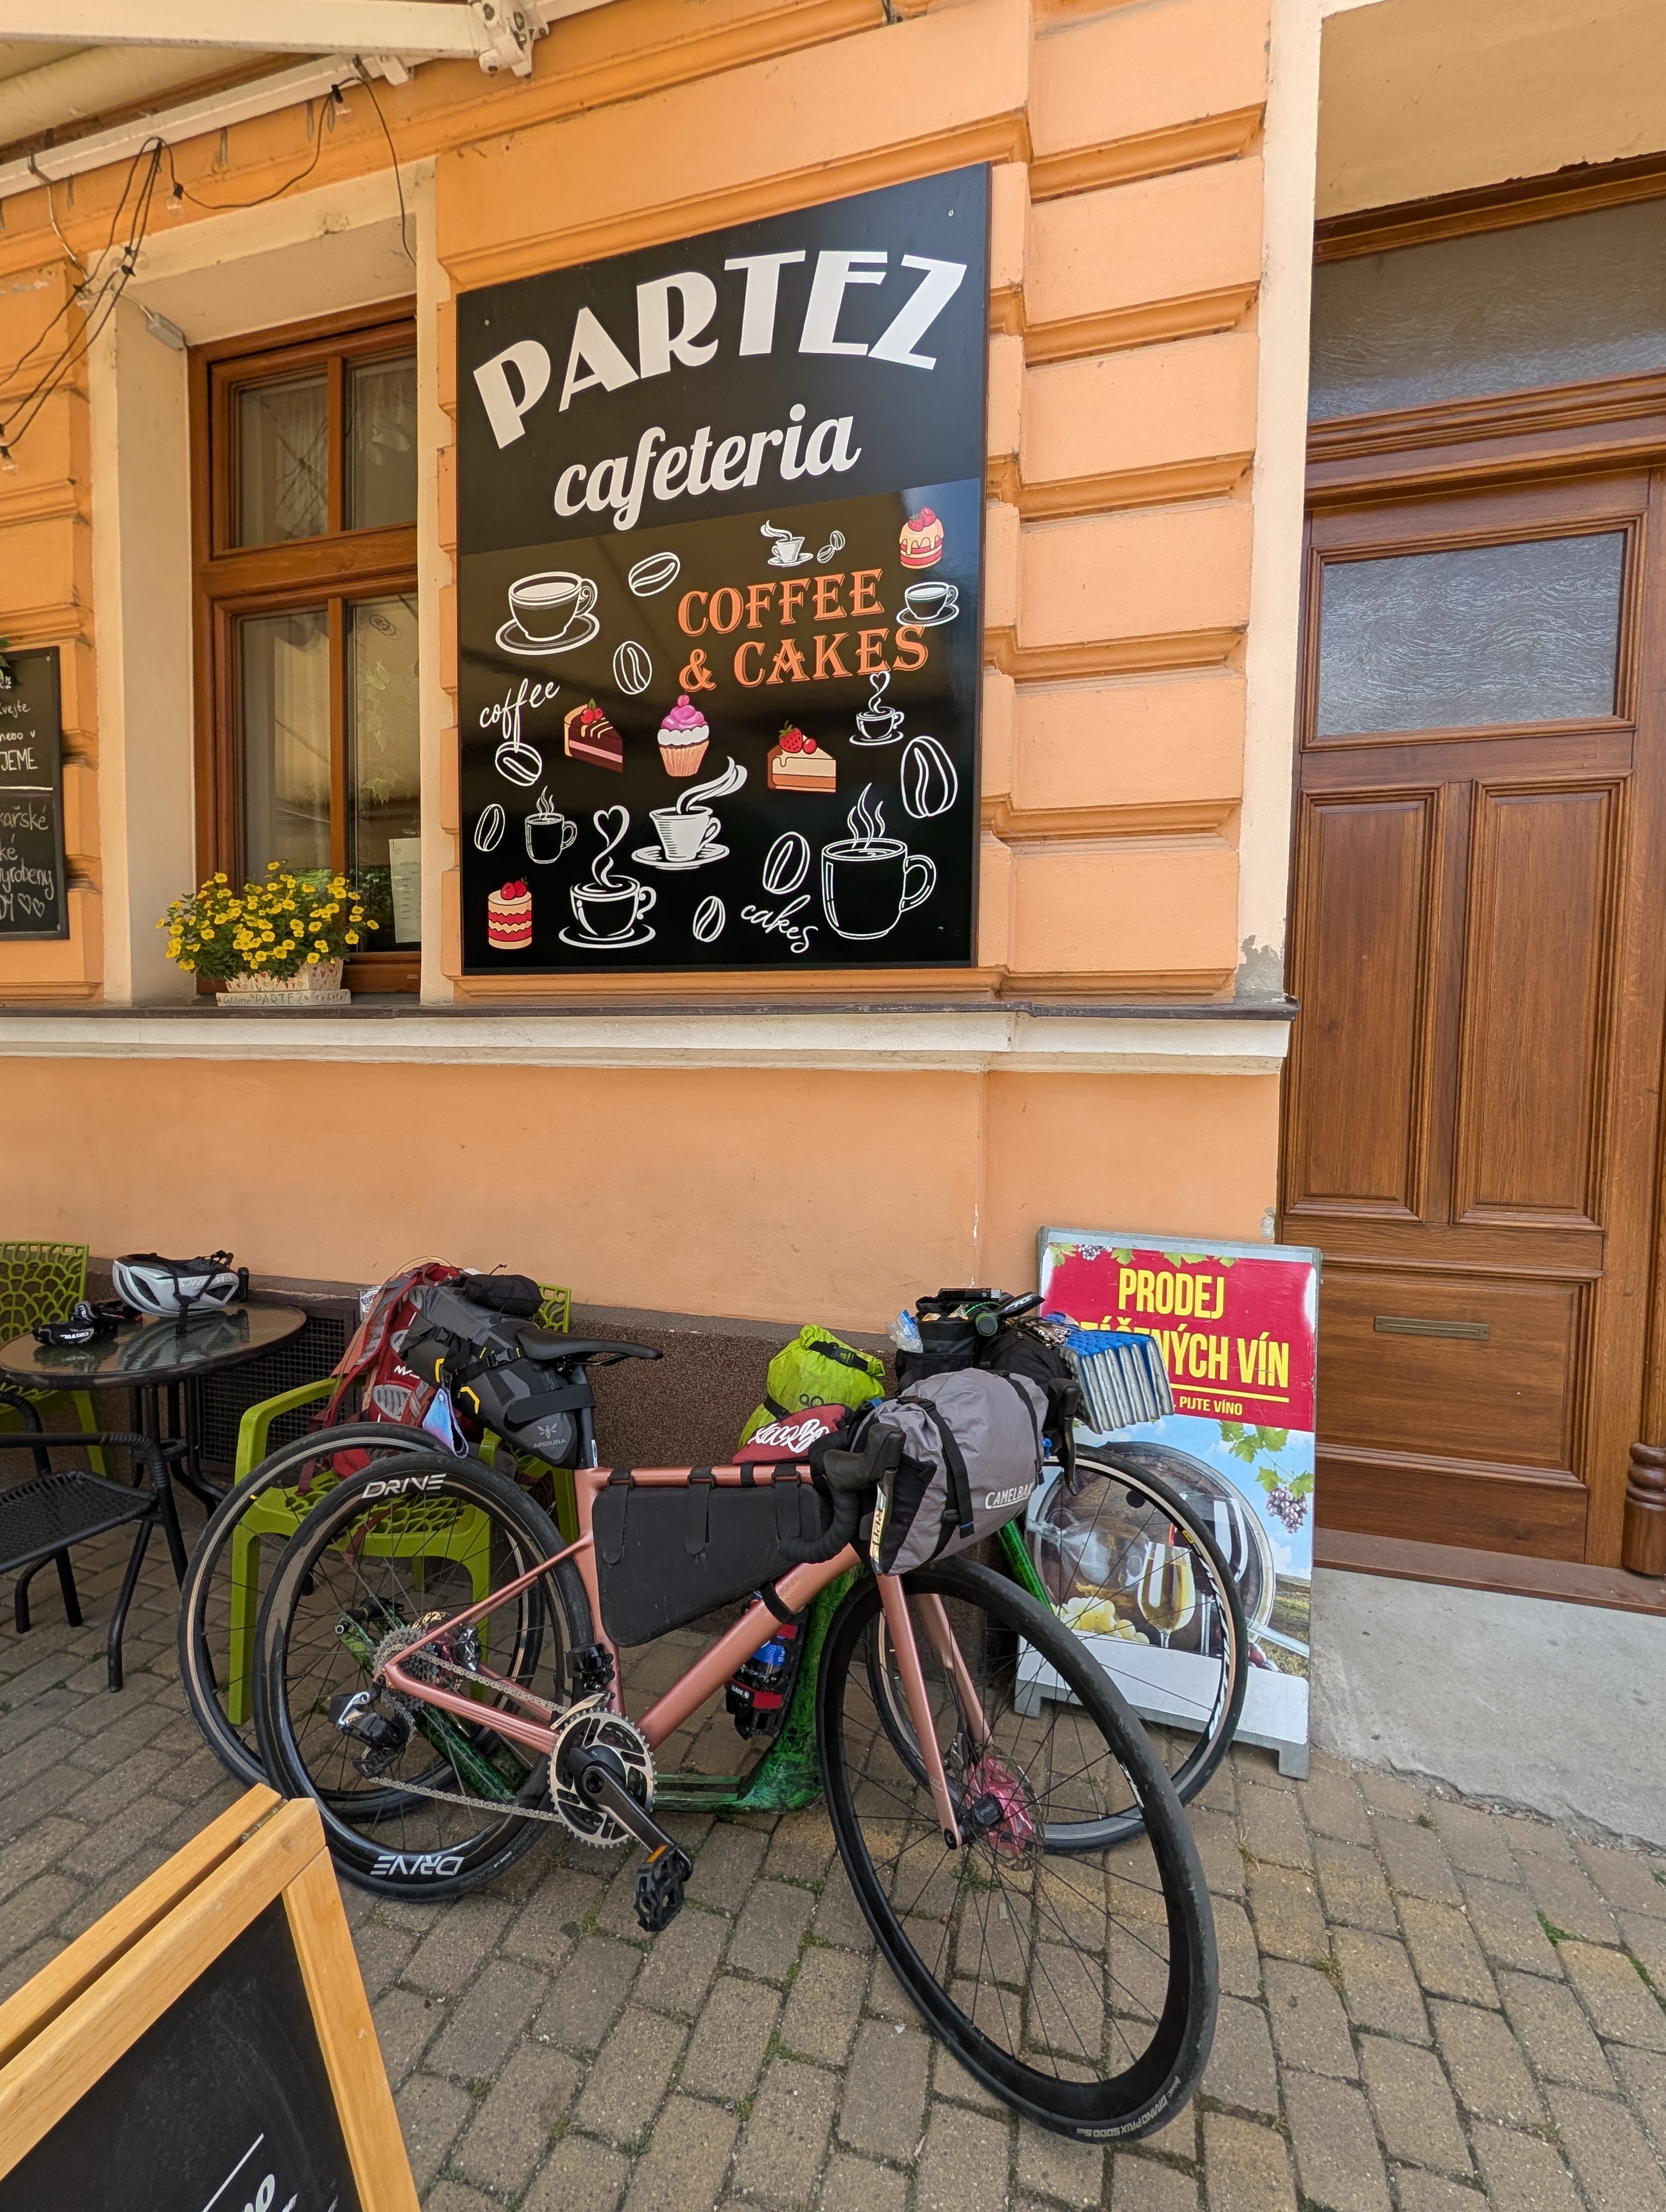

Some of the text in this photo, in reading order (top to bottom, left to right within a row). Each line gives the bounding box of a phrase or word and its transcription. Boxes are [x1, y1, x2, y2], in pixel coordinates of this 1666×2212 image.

[473, 249, 967, 449] PARTEZ
[554, 404, 862, 531] cafeteria
[678, 568, 885, 637] COFFEE
[678, 625, 929, 693] & CAKES
[479, 678, 561, 753] coffee
[0, 858, 54, 901] yrobeny
[741, 895, 819, 954] cakes
[180, 1274, 233, 1288] S-WRKS
[1118, 1268, 1225, 1320] PRODEJ
[1237, 1332, 1289, 1388] VÍN
[1179, 1396, 1243, 1416] PIJTE VÍNO
[533, 1438, 566, 1449] APIDURA
[361, 1473, 447, 1499] DRIVE
[985, 1481, 1035, 1509] CAMELBAK
[370, 1855, 465, 1876] DRIVE
